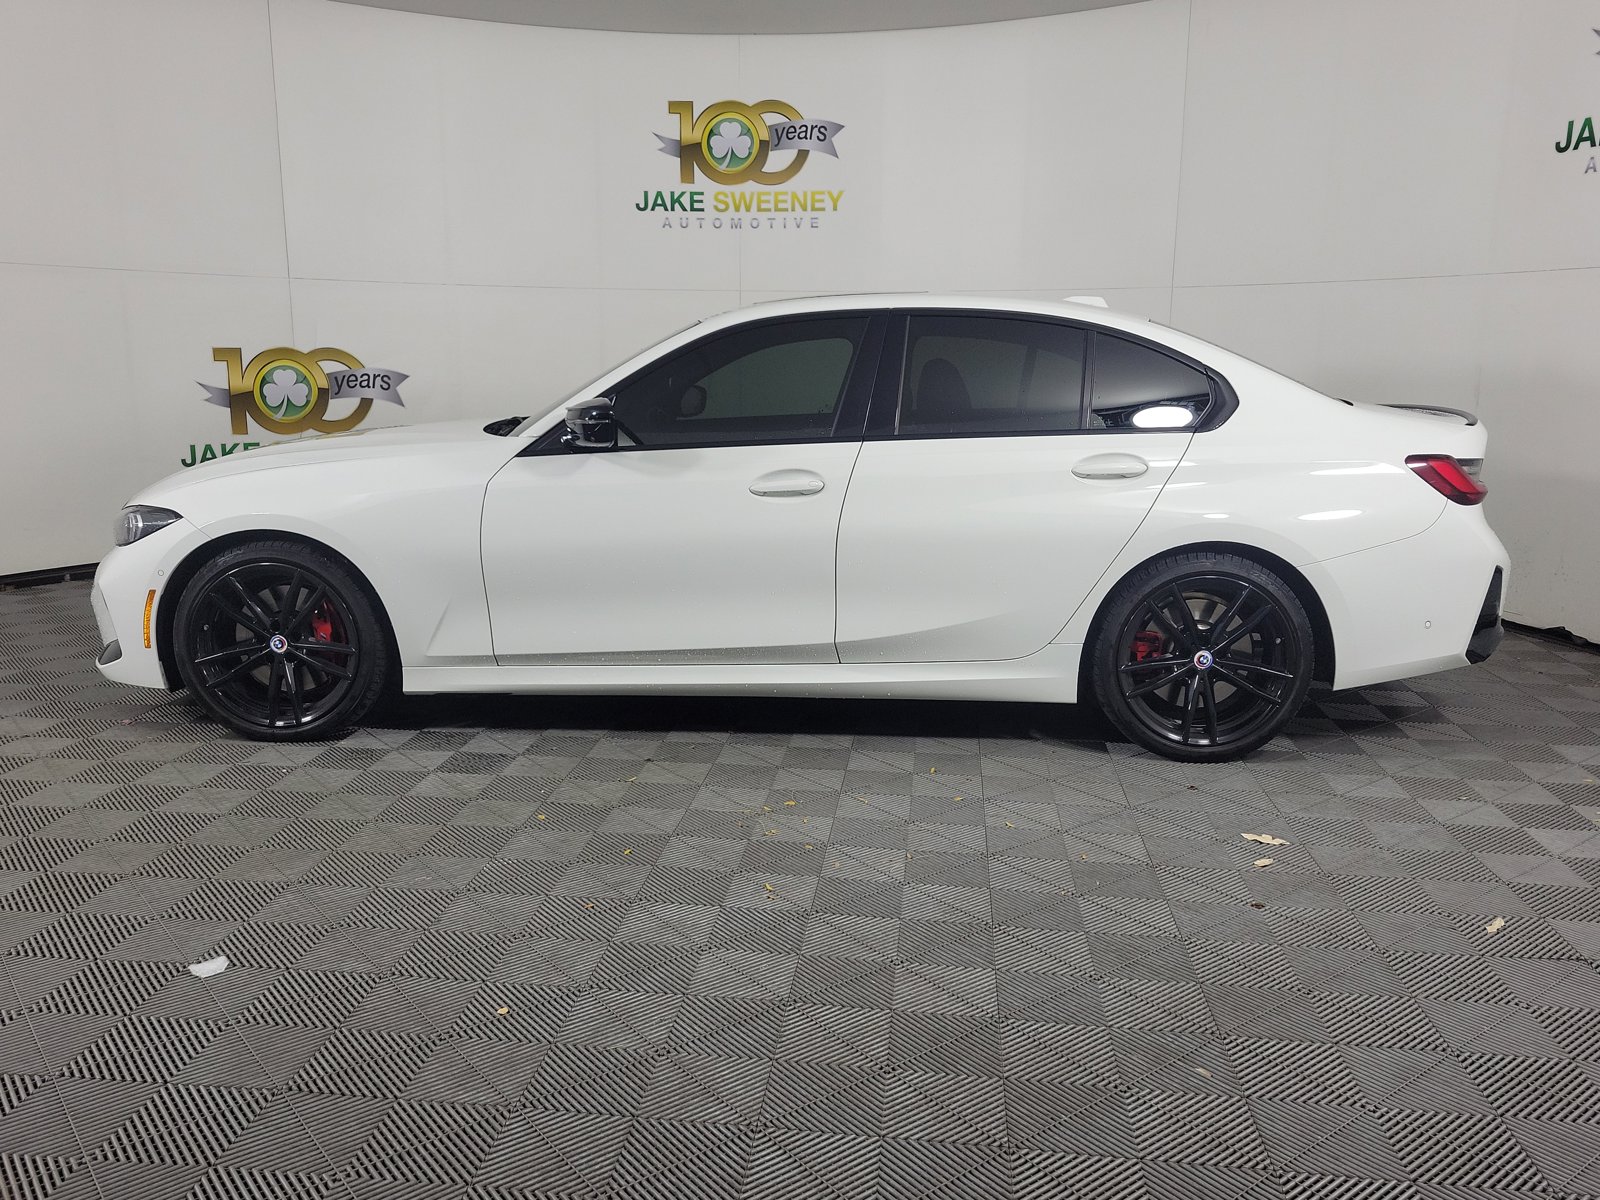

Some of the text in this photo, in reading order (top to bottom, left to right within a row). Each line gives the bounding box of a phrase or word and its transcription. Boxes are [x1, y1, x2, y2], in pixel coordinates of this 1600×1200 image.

[668, 99, 810, 186] 100
[774, 123, 828, 147] years
[635, 190, 845, 213] JAKE SWEENEY
[662, 217, 820, 230] AUTOMOTIVE
[212, 347, 374, 435] 100
[334, 372, 392, 395] years
